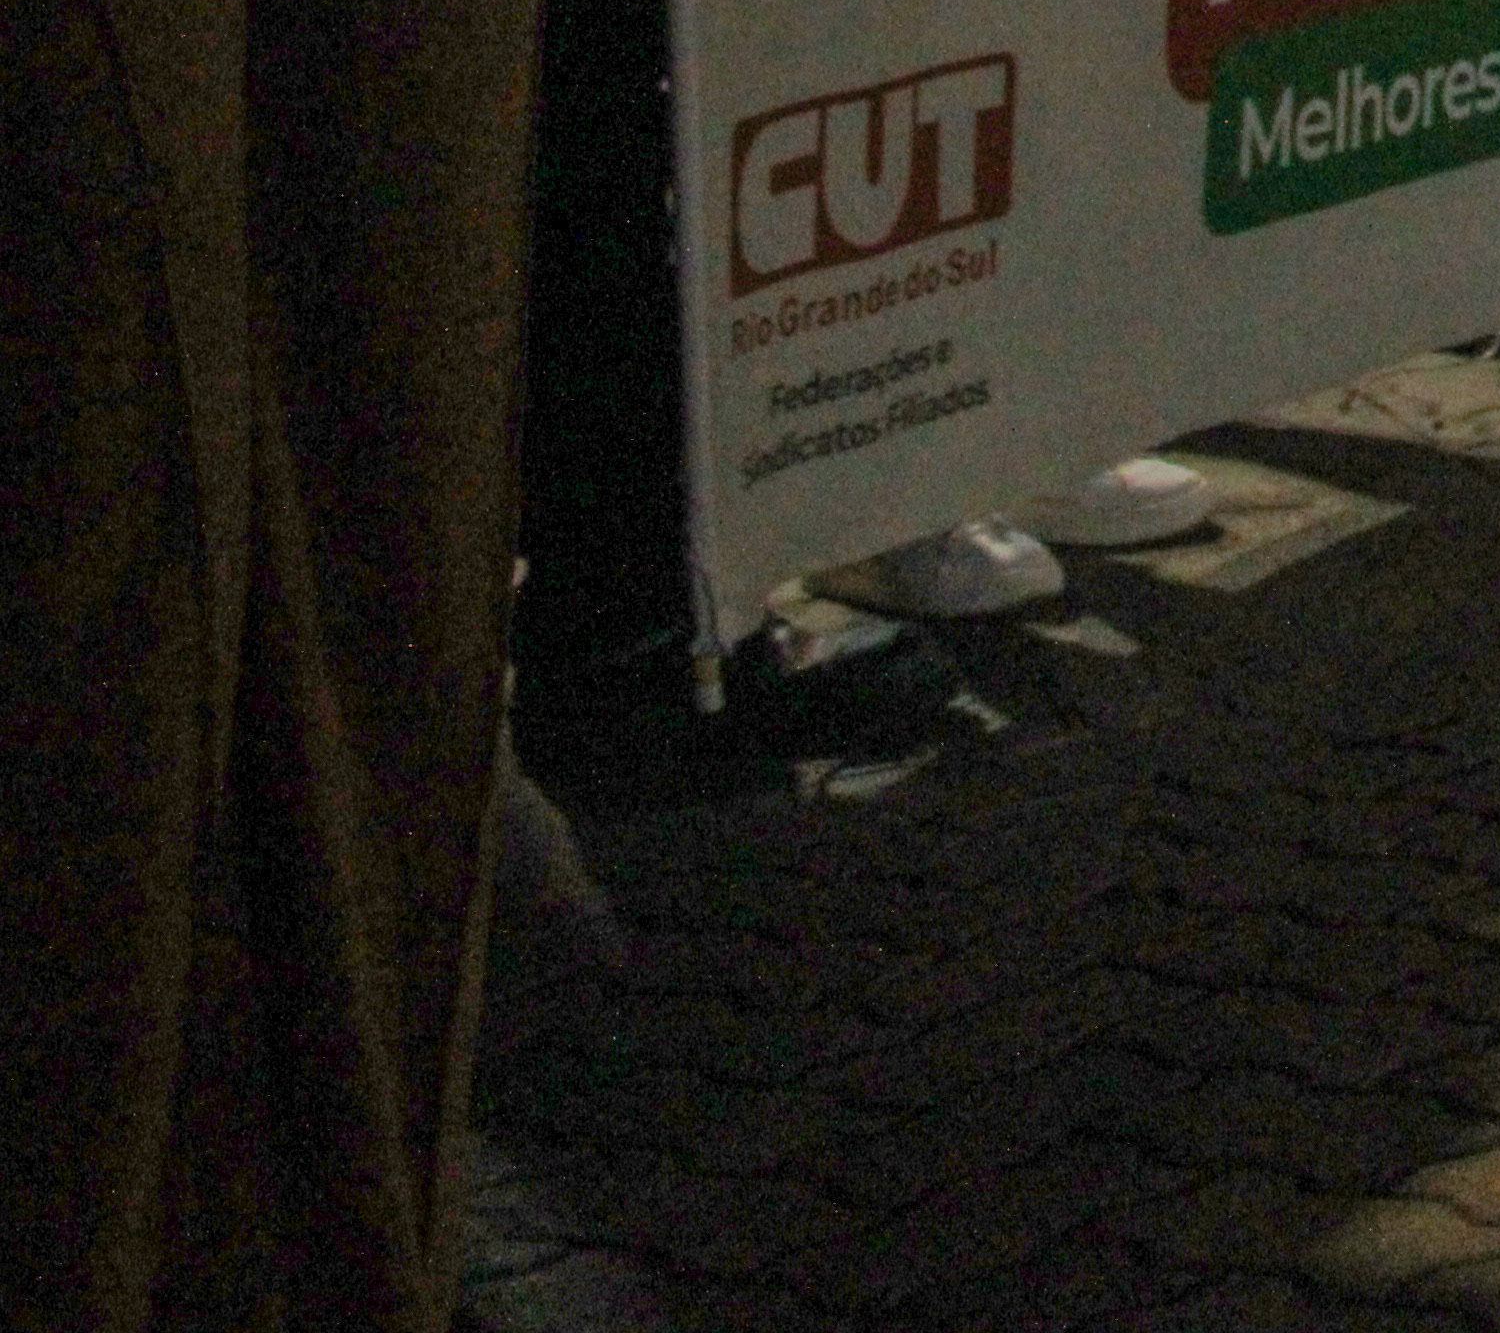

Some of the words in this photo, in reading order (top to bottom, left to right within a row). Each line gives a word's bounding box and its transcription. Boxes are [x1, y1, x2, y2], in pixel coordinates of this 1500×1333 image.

[735, 65, 1010, 277] CUT
[778, 273, 900, 339] Grande
[903, 260, 941, 300] do
[945, 237, 999, 286] Sul
